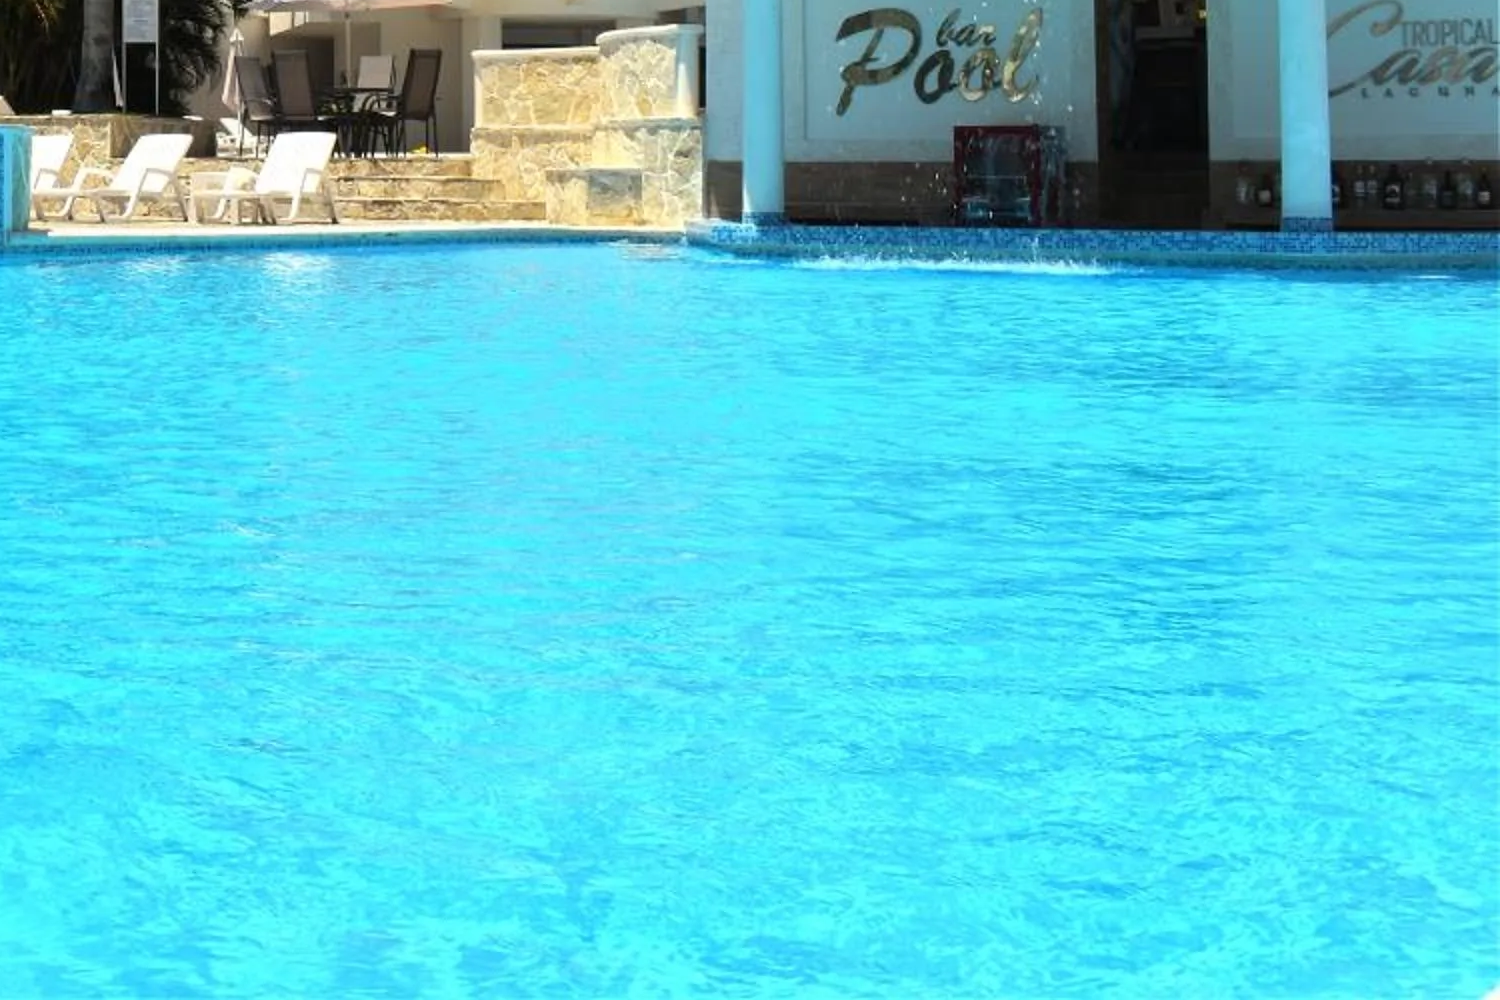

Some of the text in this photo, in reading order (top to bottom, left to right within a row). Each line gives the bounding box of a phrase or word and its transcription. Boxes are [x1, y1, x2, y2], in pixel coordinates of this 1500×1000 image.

[935, 8, 996, 47] bar
[1402, 18, 1500, 46] TROPICAL
[835, 7, 1043, 116] Pool
